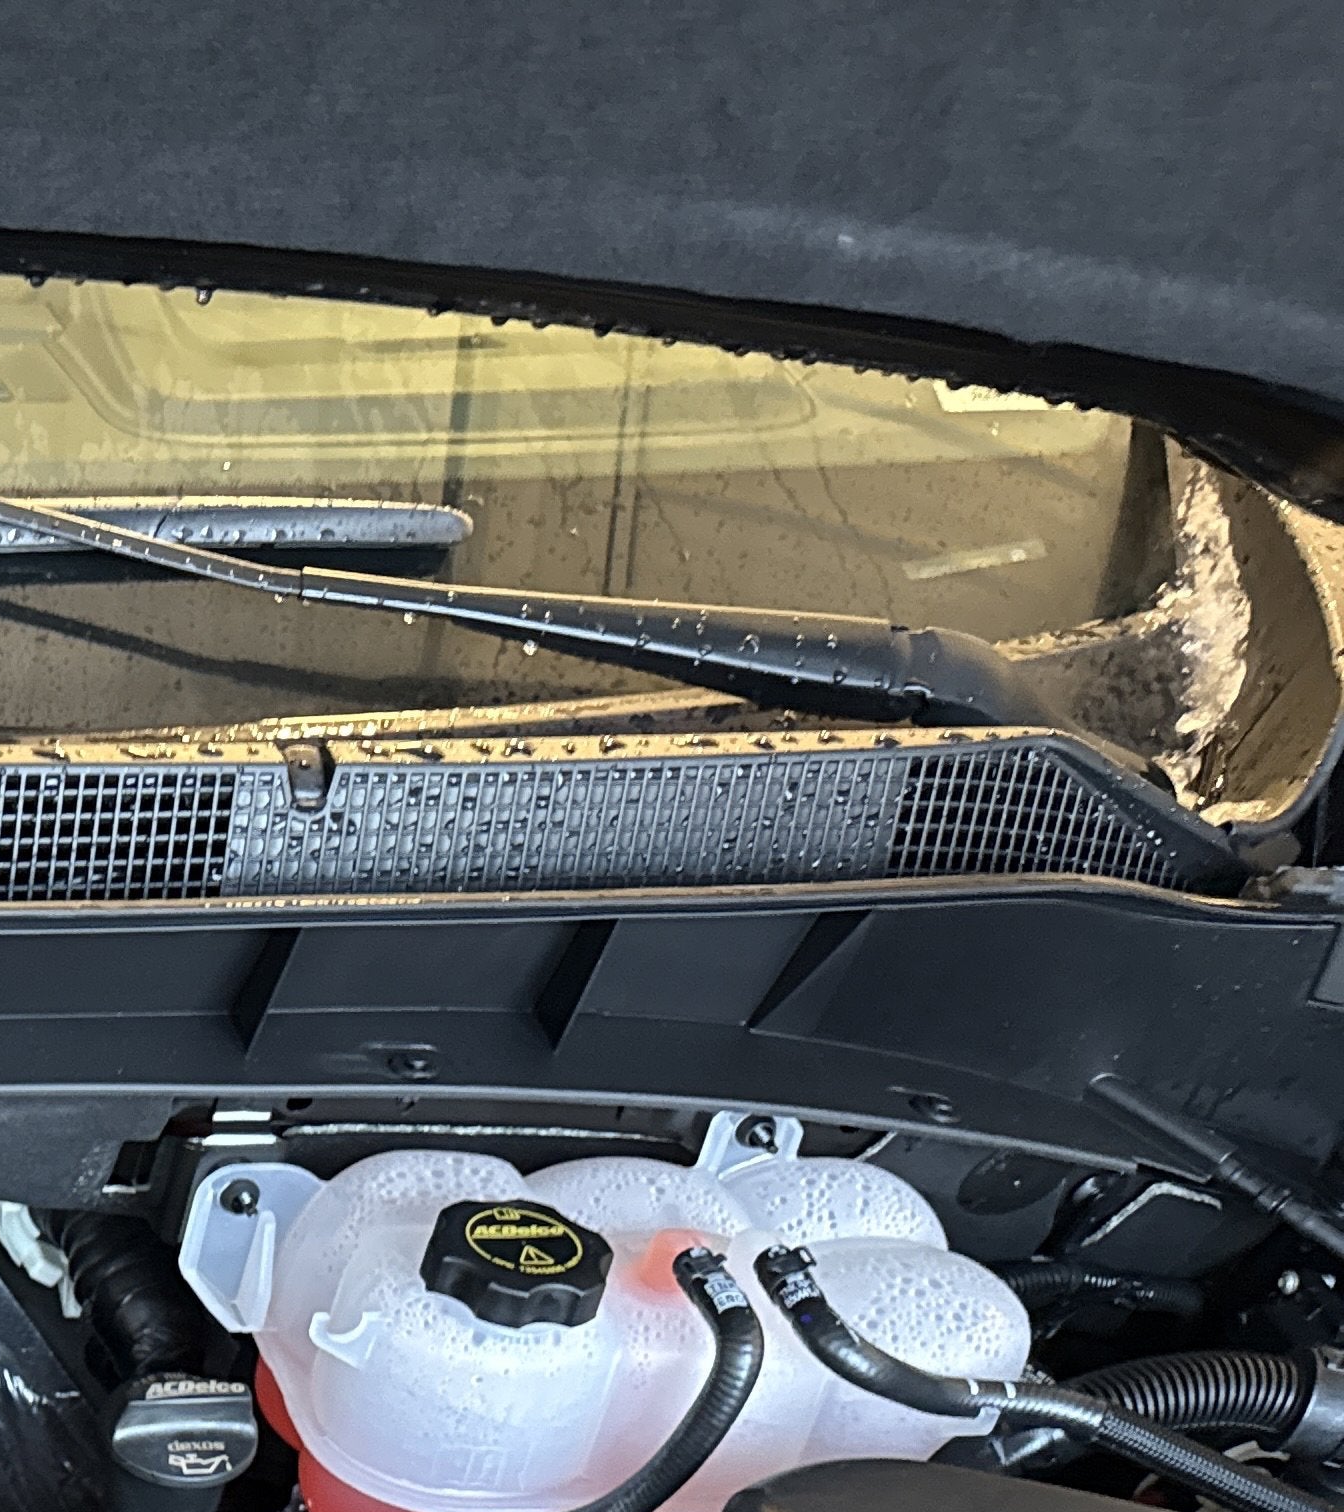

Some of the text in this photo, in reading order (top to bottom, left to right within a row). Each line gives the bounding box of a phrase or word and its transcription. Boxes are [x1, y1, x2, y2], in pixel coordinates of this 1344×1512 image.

[472, 1224, 565, 1240] ACDelco
[146, 1379, 246, 1399] ACDelco
[167, 1440, 225, 1452] dexos
